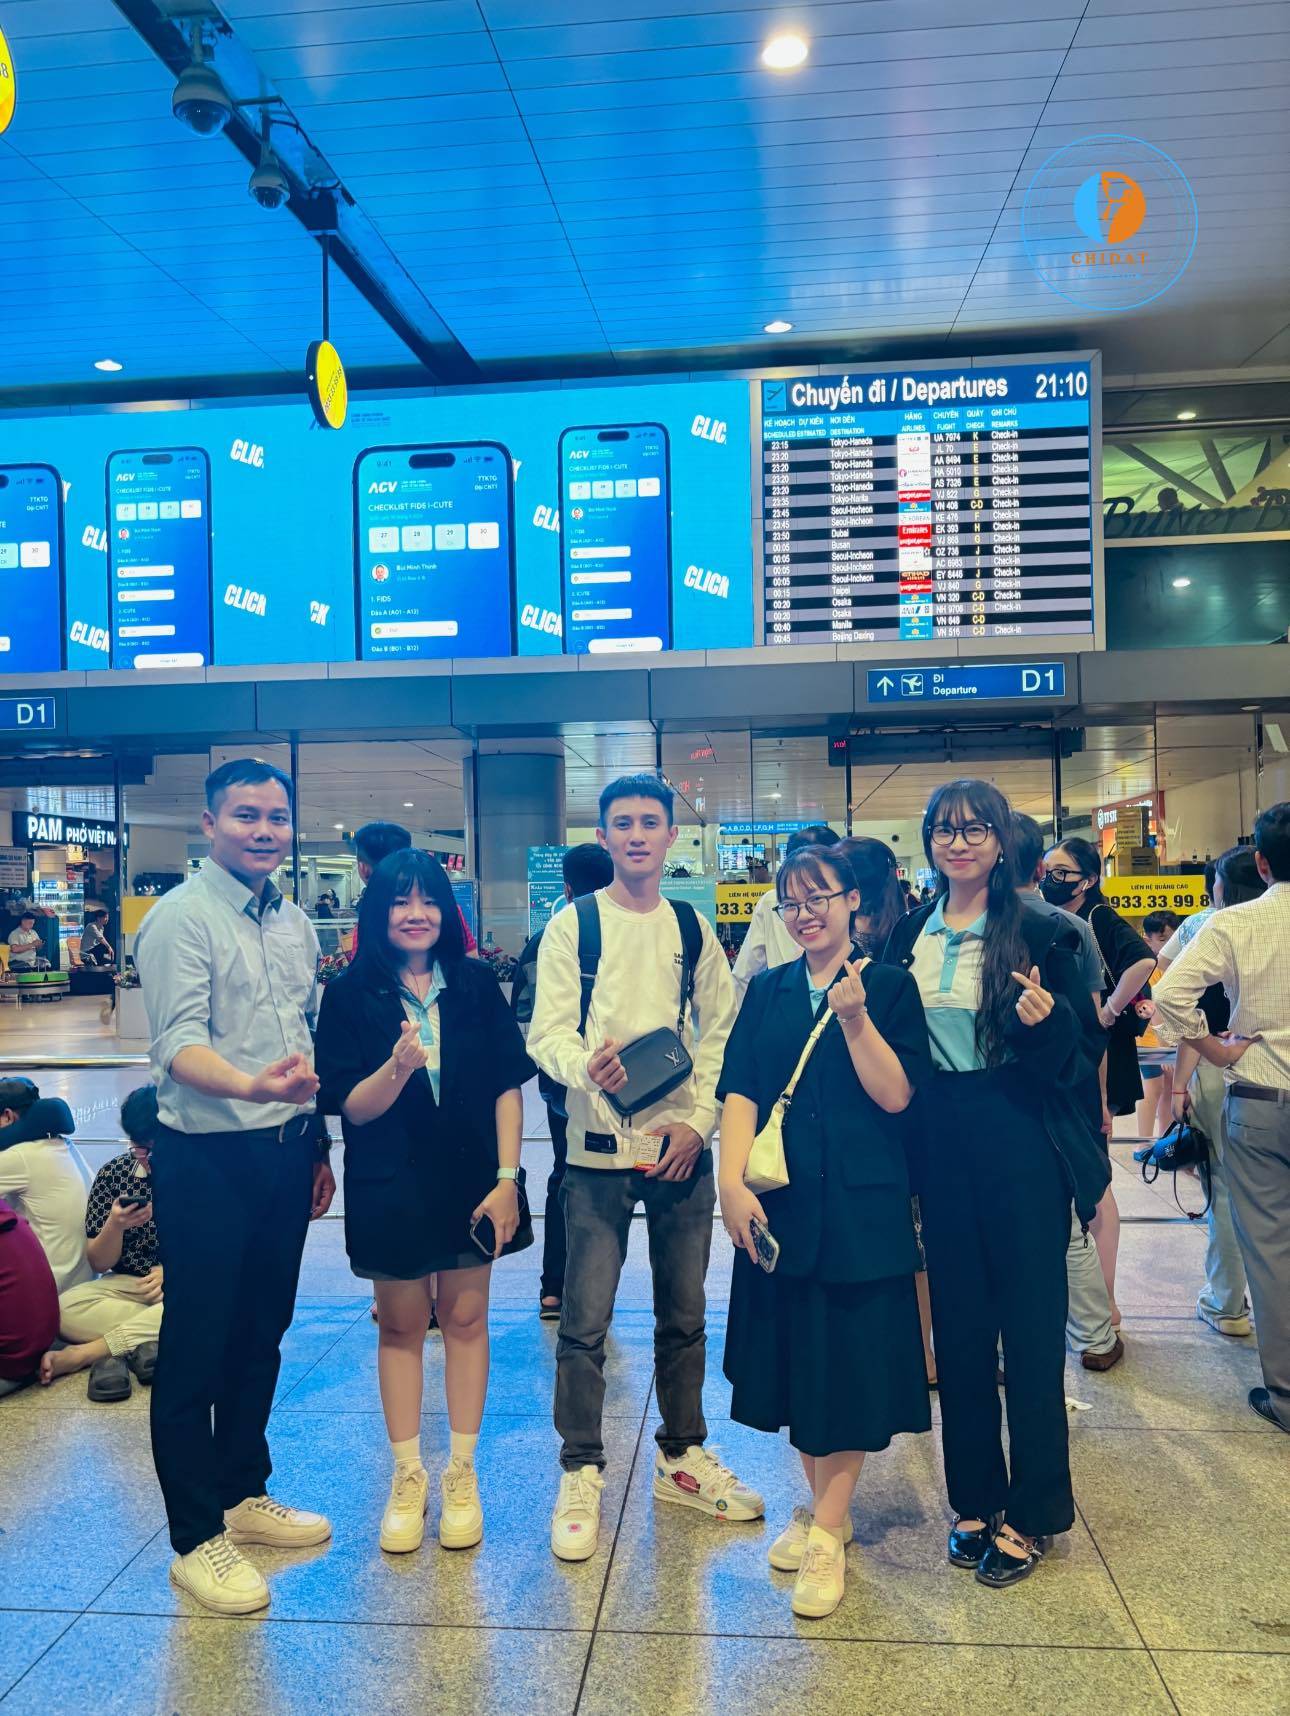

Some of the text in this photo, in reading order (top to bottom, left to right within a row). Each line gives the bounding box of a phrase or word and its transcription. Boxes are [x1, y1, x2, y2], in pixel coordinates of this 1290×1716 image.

[792, 376, 1008, 410] Chuyến đi / Departures
[1036, 372, 1088, 398] 21:10
[690, 414, 726, 444] CLIC
[772, 441, 788, 450] 23:15
[830, 438, 872, 447] Tokyo-Haneda
[934, 434, 944, 442] UA
[992, 431, 1018, 440] Check-in
[230, 438, 264, 468] CLIC
[772, 452, 788, 461] 23:20
[830, 449, 872, 458] Tokyo-Haneda
[936, 445, 944, 453] JL
[946, 444, 954, 452] 70
[992, 442, 1018, 451] Check-in
[772, 464, 788, 472] 23:20
[830, 460, 873, 470] Tokyo-Haneda
[935, 456, 944, 464] AA
[992, 454, 1018, 462] Check-in
[772, 475, 789, 484] 23:20
[830, 472, 873, 481] Tokyo-Haneda
[935, 468, 944, 476] HA
[992, 466, 1018, 474] Check-in
[772, 486, 789, 495] 23:20
[831, 483, 873, 492] Tokyo-Haneda
[935, 479, 944, 488] AS
[992, 476, 1018, 485] Check-in
[772, 498, 789, 506] 23:35
[831, 494, 868, 504] Tokyo-Narita
[936, 491, 944, 499] VJ
[992, 488, 1018, 496] Check-in
[368, 501, 426, 512] CHECKLIST FIDS
[772, 510, 789, 518] 23:45
[831, 506, 873, 515] Seoul-Incheon
[935, 502, 946, 510] VN
[992, 500, 1019, 508] Check-in
[772, 520, 789, 529] 23:45
[832, 517, 874, 526] Seoul-Incheon
[936, 514, 944, 522] KE
[993, 512, 1019, 520] Check-in
[773, 532, 789, 540] 23:50
[832, 529, 848, 538] Dubai
[936, 525, 946, 534] EK
[993, 522, 1020, 531] Check-in
[773, 544, 789, 552] 00:05
[832, 542, 850, 550] Busan
[937, 537, 946, 545] VJ
[993, 534, 1020, 542] Check-in
[773, 555, 790, 564] 00:05
[832, 551, 874, 560] Seoul-Incheon
[936, 548, 946, 556] OZ
[994, 546, 1020, 554] Check-in
[773, 566, 790, 574] 00:05
[832, 562, 874, 572] Seoul-Incheon
[936, 560, 946, 568] AC
[994, 557, 1020, 566] Check-in
[773, 578, 790, 586] 00:05
[832, 574, 874, 584] Seoul-Incheon
[936, 571, 946, 580] EY
[994, 568, 1020, 577] Check-in
[773, 590, 790, 598] 00:15
[938, 582, 946, 590] VJ
[994, 580, 1020, 588] Check-in
[773, 600, 790, 609] 00:20
[832, 598, 852, 606] Osaka
[936, 594, 946, 602] VN
[994, 592, 1020, 600] Check-in
[774, 612, 790, 620] 00:20
[832, 610, 852, 618] Osaka
[936, 606, 946, 614] NH
[994, 602, 1021, 611] Check-in
[774, 624, 790, 632] 00:40
[832, 620, 852, 629] Manila
[936, 617, 946, 626] VN
[774, 635, 790, 644] 00:45
[937, 628, 946, 636] VN
[995, 626, 1021, 634] Check-in
[934, 674, 944, 682] ĐI
[1022, 669, 1054, 692] D1
[934, 686, 977, 696] Departure
[16, 703, 46, 724] D1
[27, 815, 62, 842] PAM
[66, 822, 88, 843] PHỞ
[88, 825, 106, 848] VIỆT
[1107, 894, 1210, 908] 933.33.99.8
